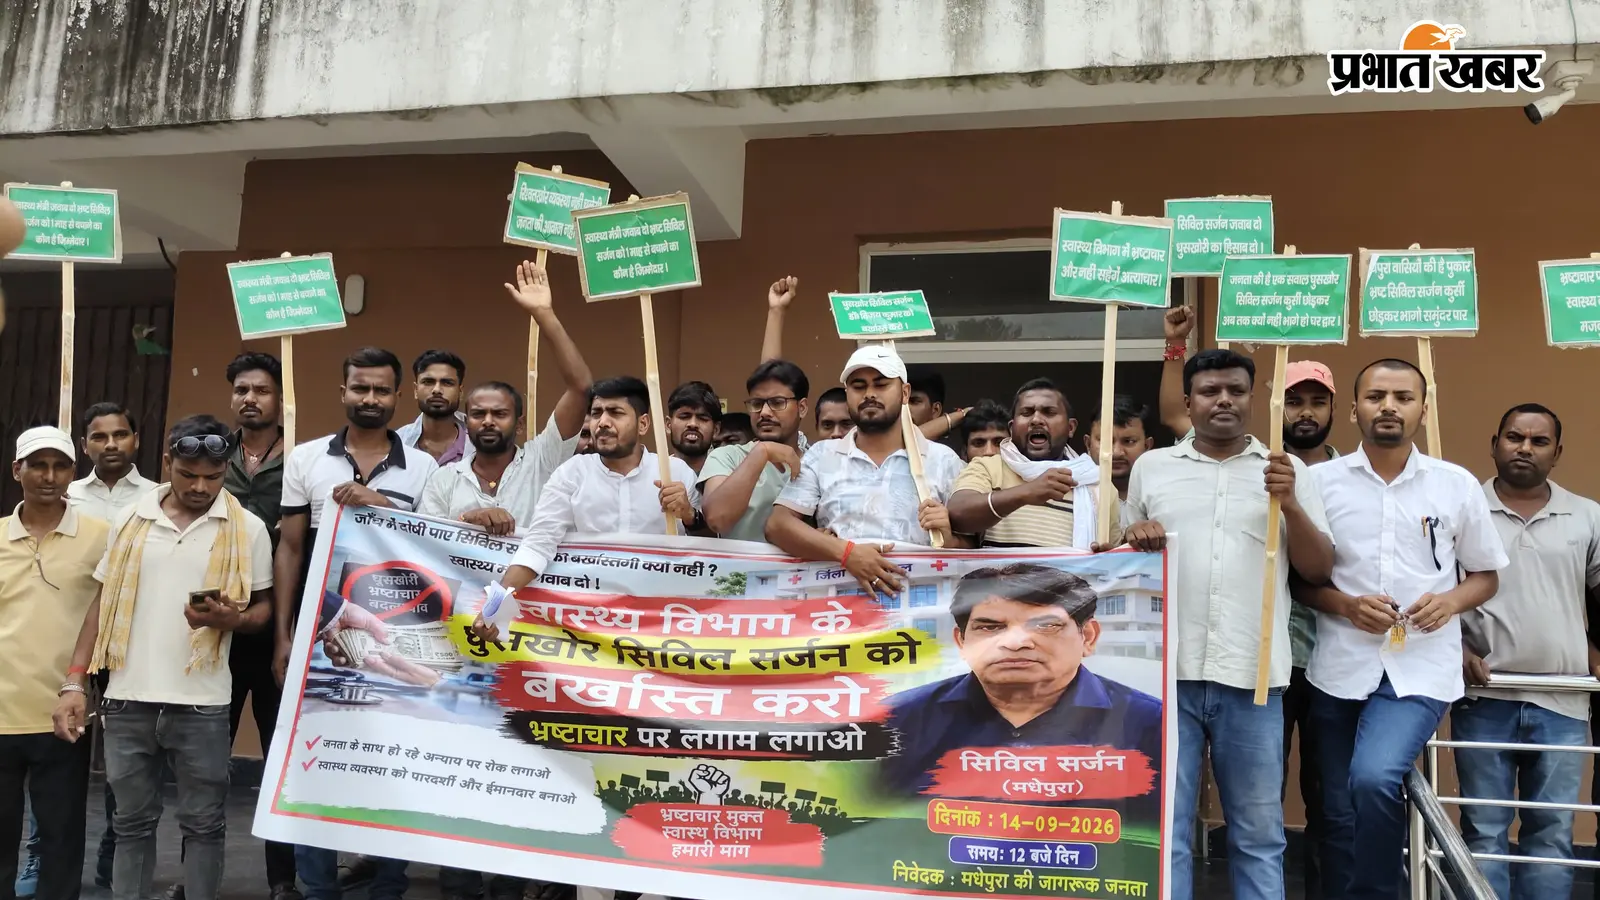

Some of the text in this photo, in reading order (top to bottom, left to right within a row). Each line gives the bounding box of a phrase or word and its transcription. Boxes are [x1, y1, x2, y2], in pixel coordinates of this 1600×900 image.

[90, 203, 111, 215] सिविल
[40, 217, 50, 228] को
[68, 218, 75, 229] से
[93, 221, 102, 230] का
[516, 216, 534, 230] जनता
[534, 213, 544, 232] की
[584, 218, 685, 243] स्वास्थ्य मंत्री जवाब दो भ्रष्ट सिविल
[1177, 215, 1262, 231] सिविल सर्जन जवाब दो
[35, 233, 50, 244] कौन
[51, 234, 57, 245] है
[1210, 242, 1222, 253] का
[1223, 238, 1248, 254] हिसाब
[1249, 239, 1258, 254] दो
[596, 240, 679, 262] सर्जन को माह से बचाने का
[1062, 238, 1166, 262] स्वास्थ्य विभाग में भ्रष्टाचार
[309, 269, 331, 281] सिविल
[612, 262, 664, 279] कौन है जिम्मेदार
[1061, 260, 1078, 279] और
[1423, 257, 1436, 273] की
[1438, 257, 1445, 274] है
[1446, 261, 1472, 278] पुकार
[1230, 274, 1252, 285] जनता
[1253, 271, 1264, 285] की
[1265, 271, 1271, 285] है
[1272, 274, 1285, 285] एक
[1286, 274, 1309, 285] सवाल
[1560, 271, 1595, 286] भ्रष्टाचार
[249, 292, 267, 305] सर्जन
[267, 292, 276, 302] को
[293, 289, 300, 300] से
[1370, 280, 1466, 303] भ्रष्ट सिविल सर्जन कुर्सी
[1236, 292, 1260, 305] सिविल
[1261, 292, 1282, 305] सर्जन
[1284, 292, 1302, 311] कुर्सी
[1565, 296, 1597, 308] स्वास्थ्य
[266, 307, 281, 319] कौन
[1222, 315, 1236, 326] अब
[1236, 316, 1251, 326] तक
[1283, 313, 1299, 326] भागे
[1300, 313, 1309, 327] हो
[1400, 306, 1423, 322] भागो
[1453, 309, 1468, 321] पार
[386, 517, 398, 531] में
[399, 519, 427, 537] दोषी
[428, 528, 455, 542] पाए
[455, 529, 505, 551] सिविल
[449, 554, 495, 572] स्वास्थ्य
[673, 561, 705, 577] नहीं
[372, 572, 419, 586] घूसखोरी
[574, 574, 590, 589] दो
[660, 603, 796, 636] विभाग
[810, 601, 852, 634] के
[612, 637, 736, 671] सिविल
[749, 637, 851, 671] सर्जन
[865, 632, 922, 665] को
[521, 673, 870, 718] बर्खास्त करो
[529, 720, 866, 752] भ्रष्टाचार पर लगाम लगाओ
[323, 739, 551, 779] जनता के साथ हो रहे अन्याय पर रोक लगाओ
[959, 750, 1126, 773] सिविल सर्जन
[318, 760, 577, 805] स्वास्थ्य व्यवस्था को पारदर्शी और ईमानदार बनाओ
[1002, 778, 1084, 797] (मधेपुरा)
[660, 807, 764, 826] भ्रष्टाचार मुक्त
[934, 802, 1115, 836] दिनांक 14-09-2026
[662, 823, 762, 840] स्वास्थ विभाग
[672, 839, 750, 858] हमारी मांग
[1009, 847, 1025, 862] 12
[1030, 844, 1051, 864] बजे
[1055, 844, 1079, 865] दिन
[892, 860, 1148, 897] निवेदक मधेपुरा की जागरूक जनता
